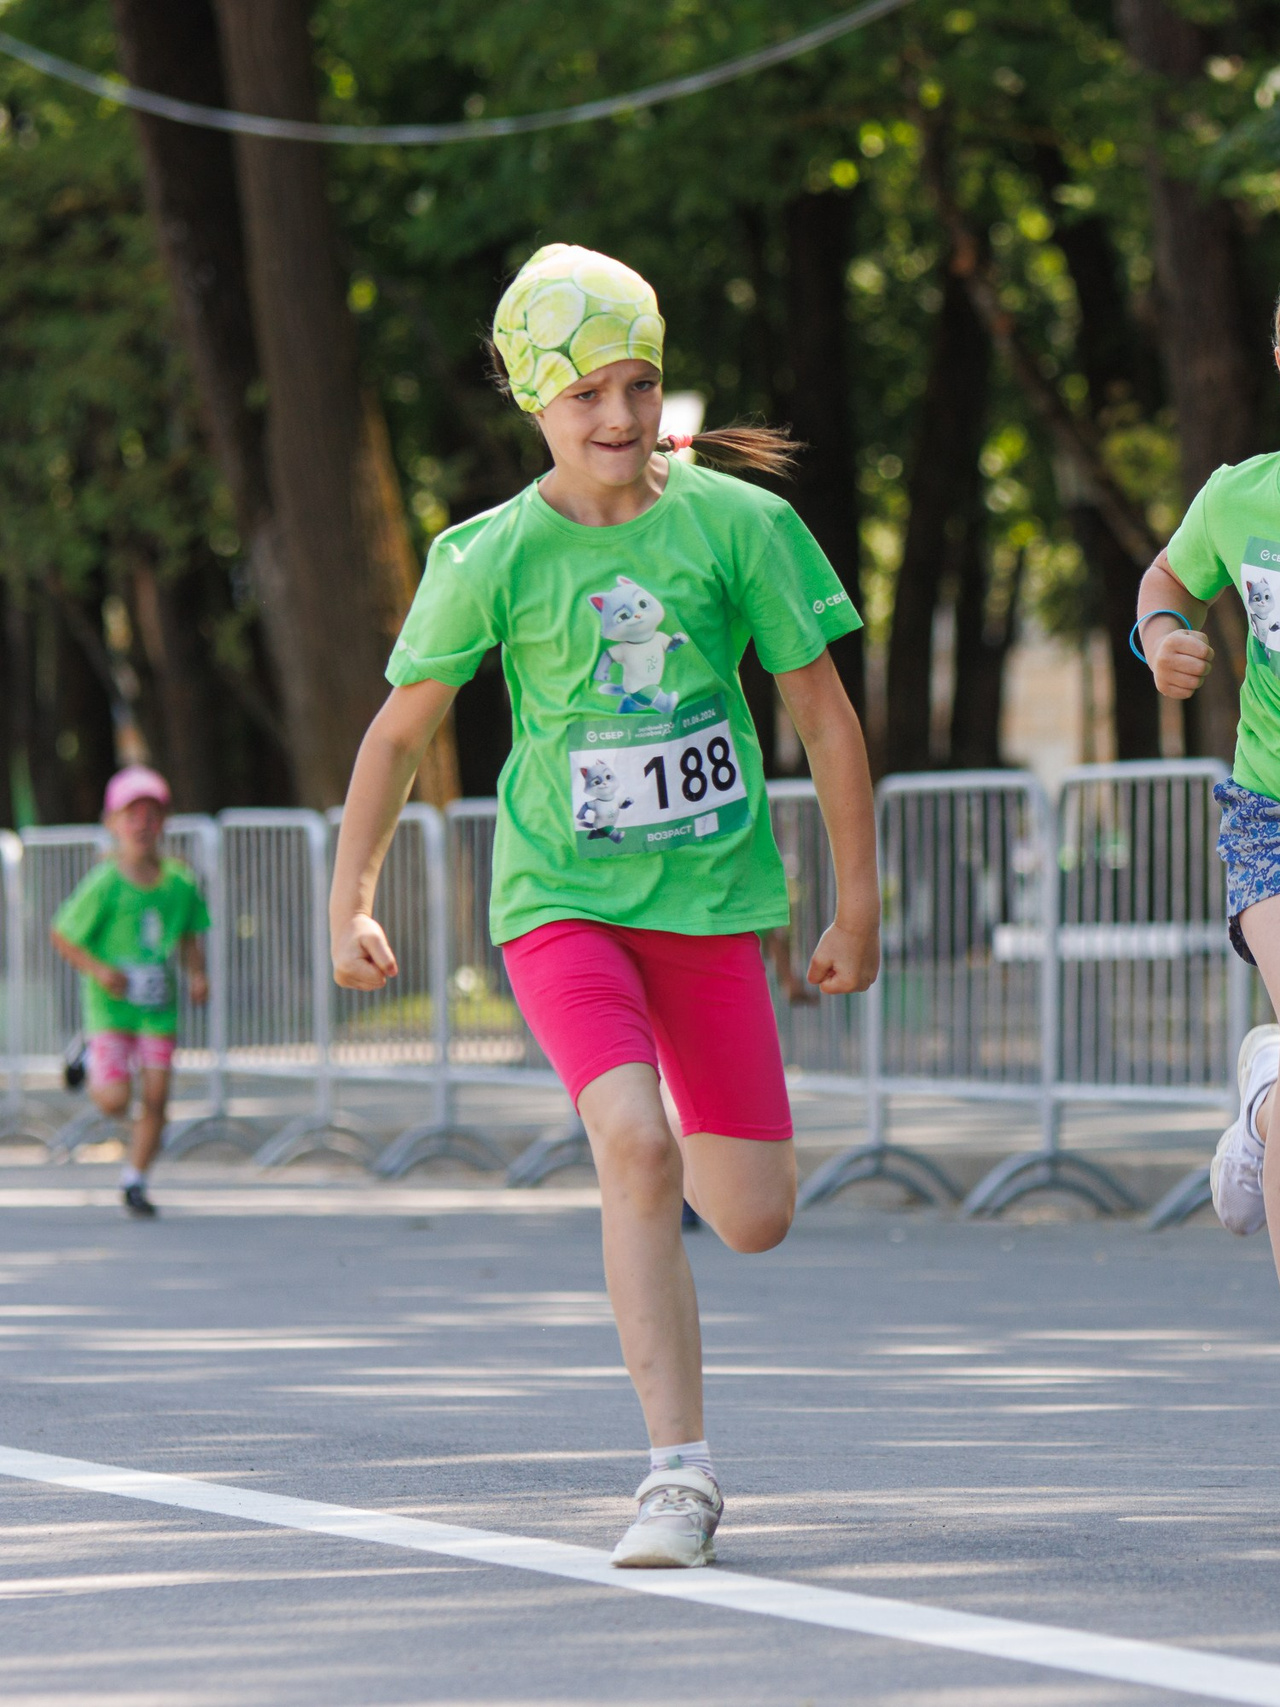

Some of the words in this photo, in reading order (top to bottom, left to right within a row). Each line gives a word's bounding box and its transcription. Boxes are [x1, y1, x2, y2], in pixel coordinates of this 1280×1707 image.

[682, 708, 716, 728] 01.06.2024
[599, 731, 624, 740] СБЕР
[644, 736, 737, 810] 188
[647, 825, 692, 842] ВОЗРАСТ
